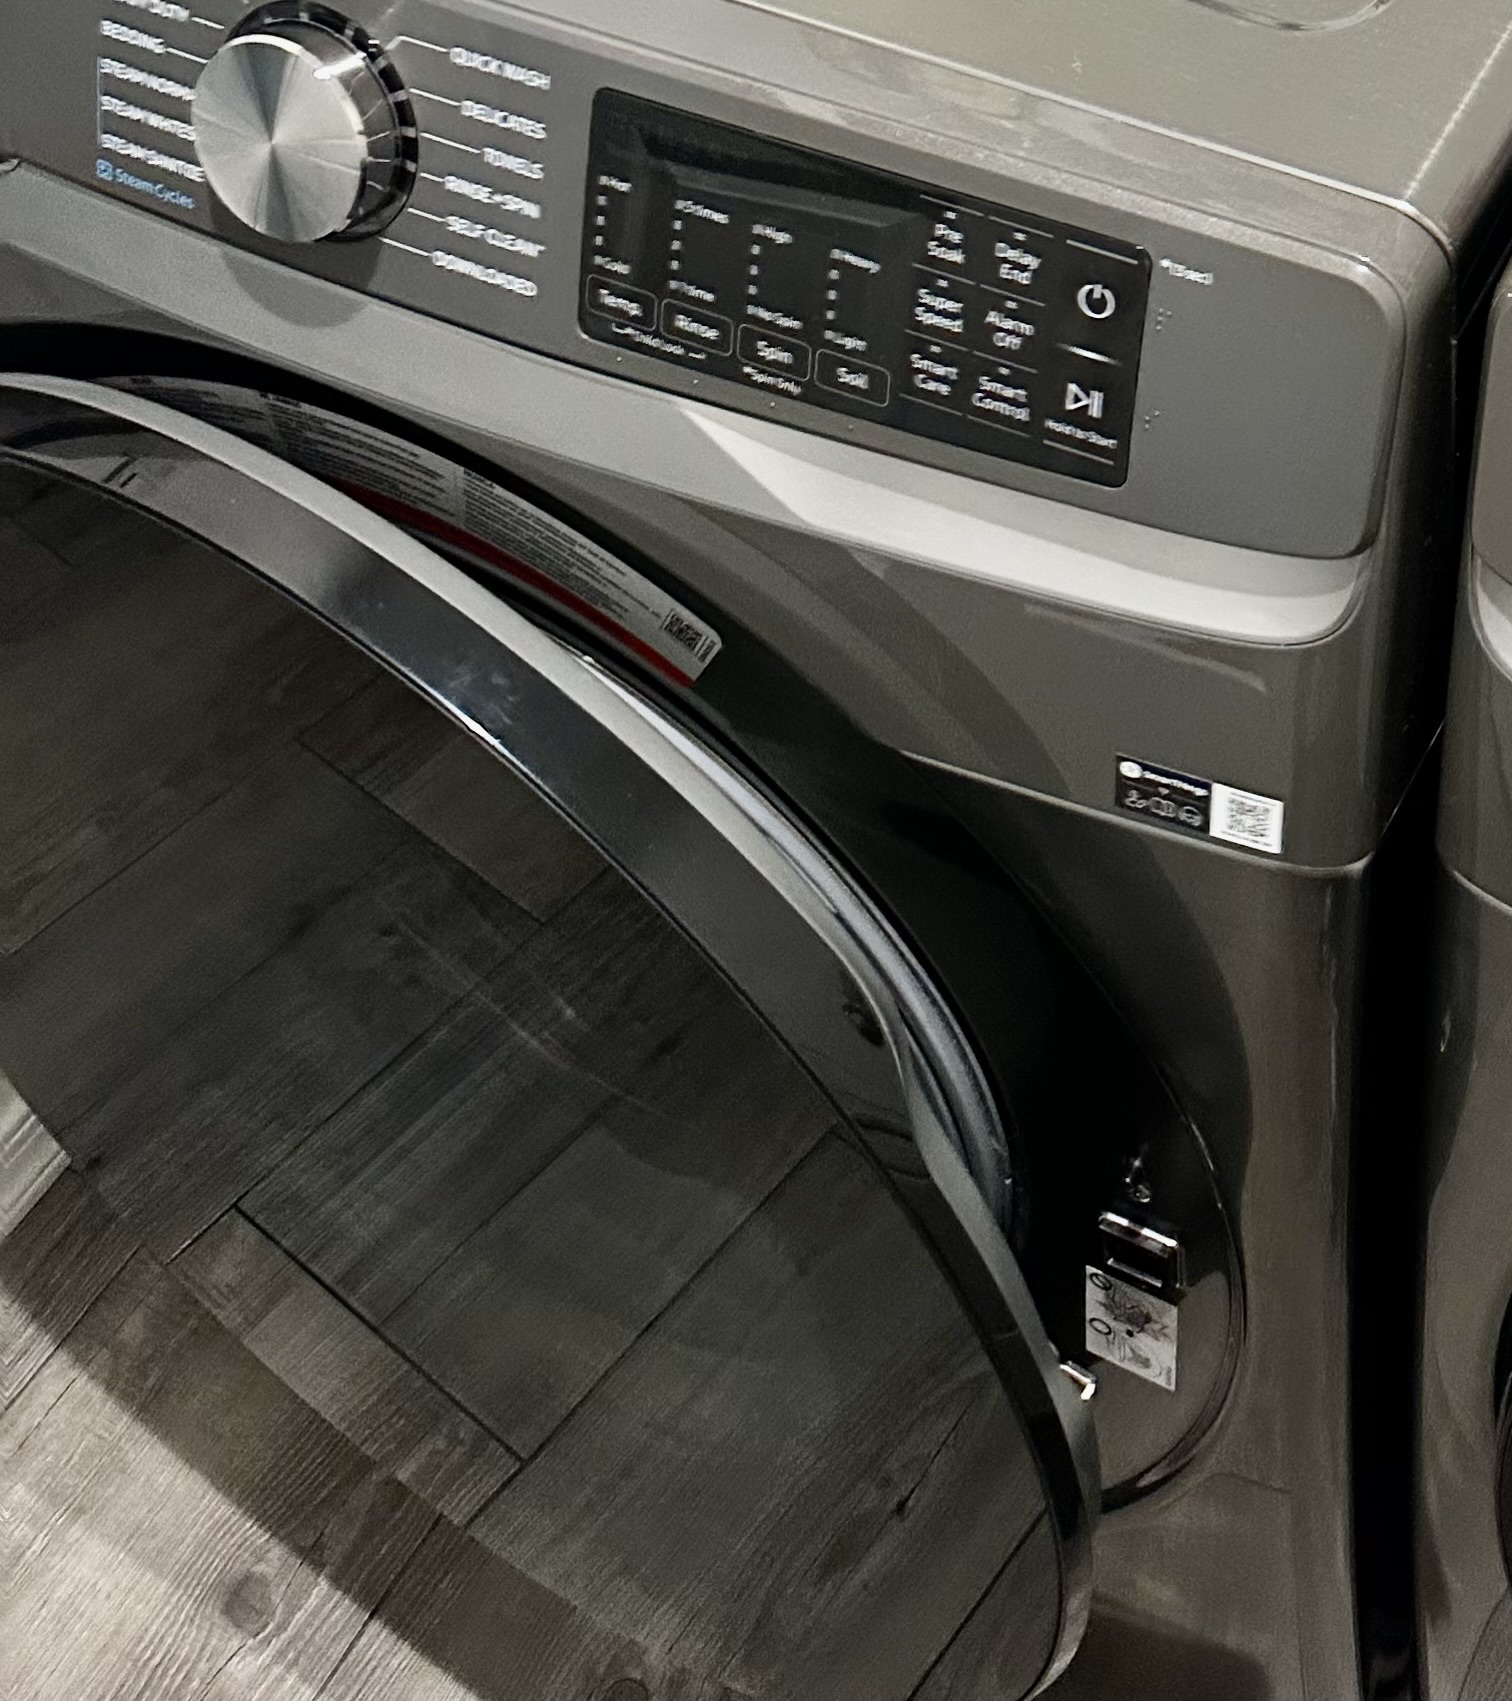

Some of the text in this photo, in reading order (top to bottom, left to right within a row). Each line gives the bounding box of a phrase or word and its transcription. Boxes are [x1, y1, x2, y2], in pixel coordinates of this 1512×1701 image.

[934, 223, 964, 244] Pre
[927, 241, 966, 265] Soak
[995, 242, 1042, 270] Delay
[1000, 263, 1032, 285] End
[917, 288, 964, 313] Super
[675, 314, 720, 341] Rinse
[914, 306, 964, 333] Speed
[983, 311, 1035, 336] Alarm
[757, 340, 794, 364] Spin
[837, 367, 869, 390] Soil
[910, 353, 959, 380] Smart
[913, 373, 952, 396] Care
[979, 376, 1028, 402] Smart
[971, 392, 1030, 422] Control
